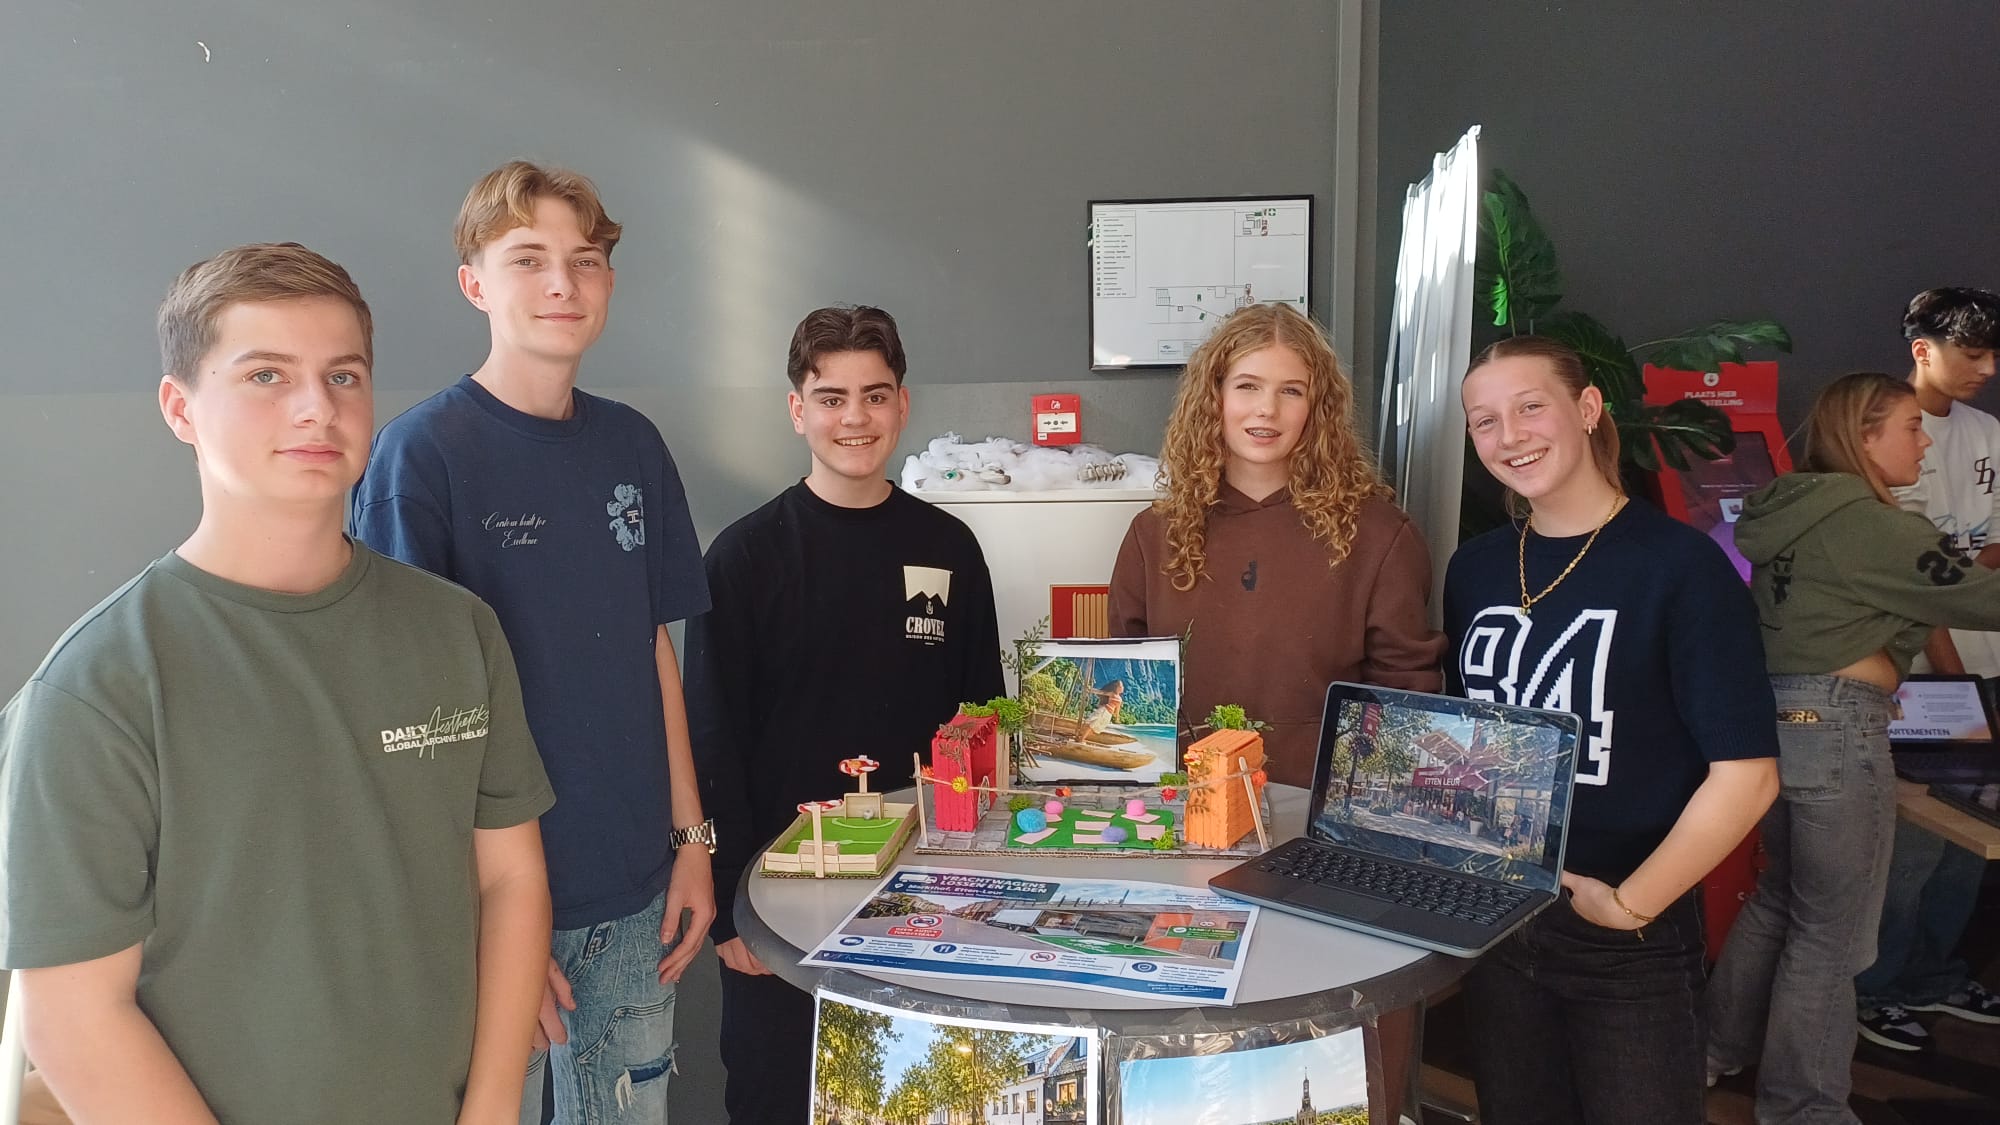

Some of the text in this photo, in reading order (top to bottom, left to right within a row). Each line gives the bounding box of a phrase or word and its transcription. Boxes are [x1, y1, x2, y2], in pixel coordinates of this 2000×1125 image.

[906, 616, 944, 636] CROYEZ
[381, 724, 428, 744] DAILY
[383, 741, 424, 753] GLOBAL
[423, 735, 457, 746] ARCHIVE
[940, 880, 984, 888] LOSSEN
[942, 875, 1047, 889] VRACHTWAGENS
